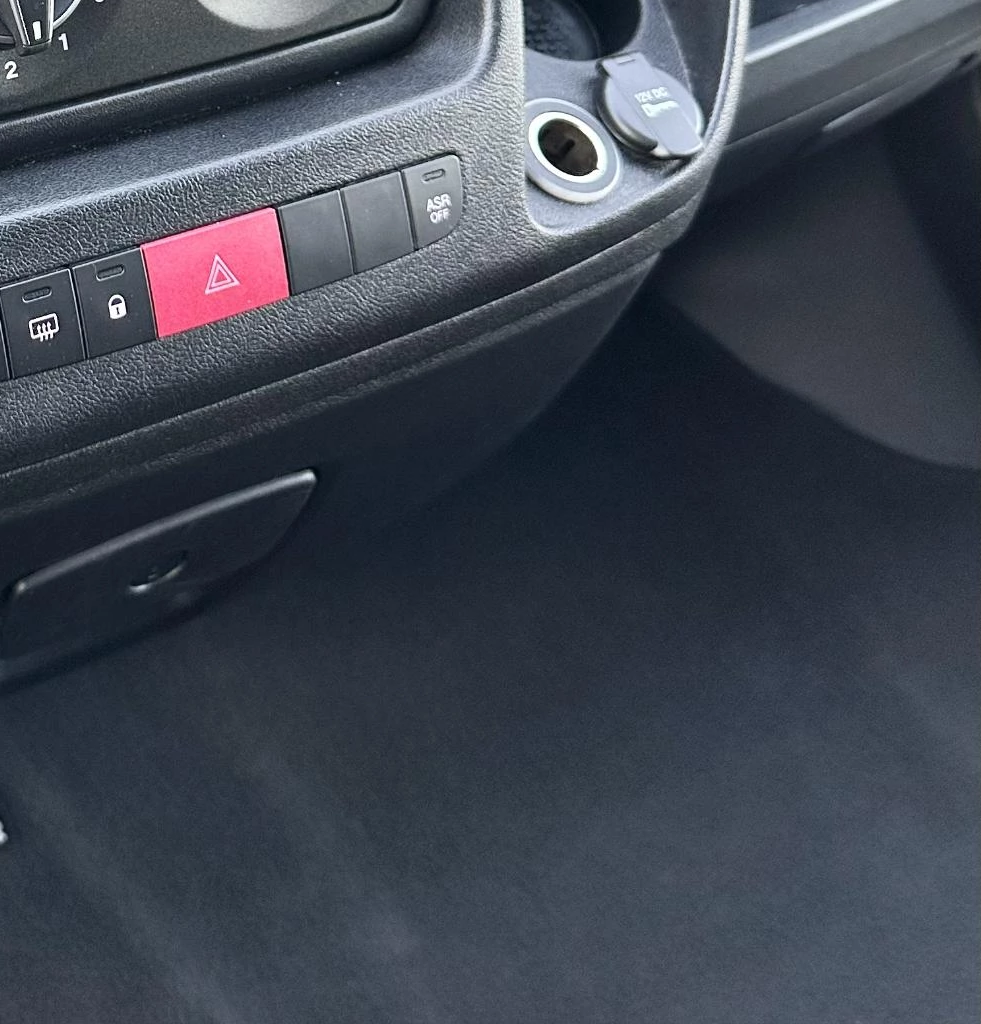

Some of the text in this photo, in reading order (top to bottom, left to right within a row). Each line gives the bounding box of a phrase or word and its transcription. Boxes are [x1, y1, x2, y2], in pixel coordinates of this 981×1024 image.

[58, 33, 69, 51] 1
[4, 61, 18, 80] 2
[426, 193, 452, 212] ASR
[430, 208, 450, 224] OFF
